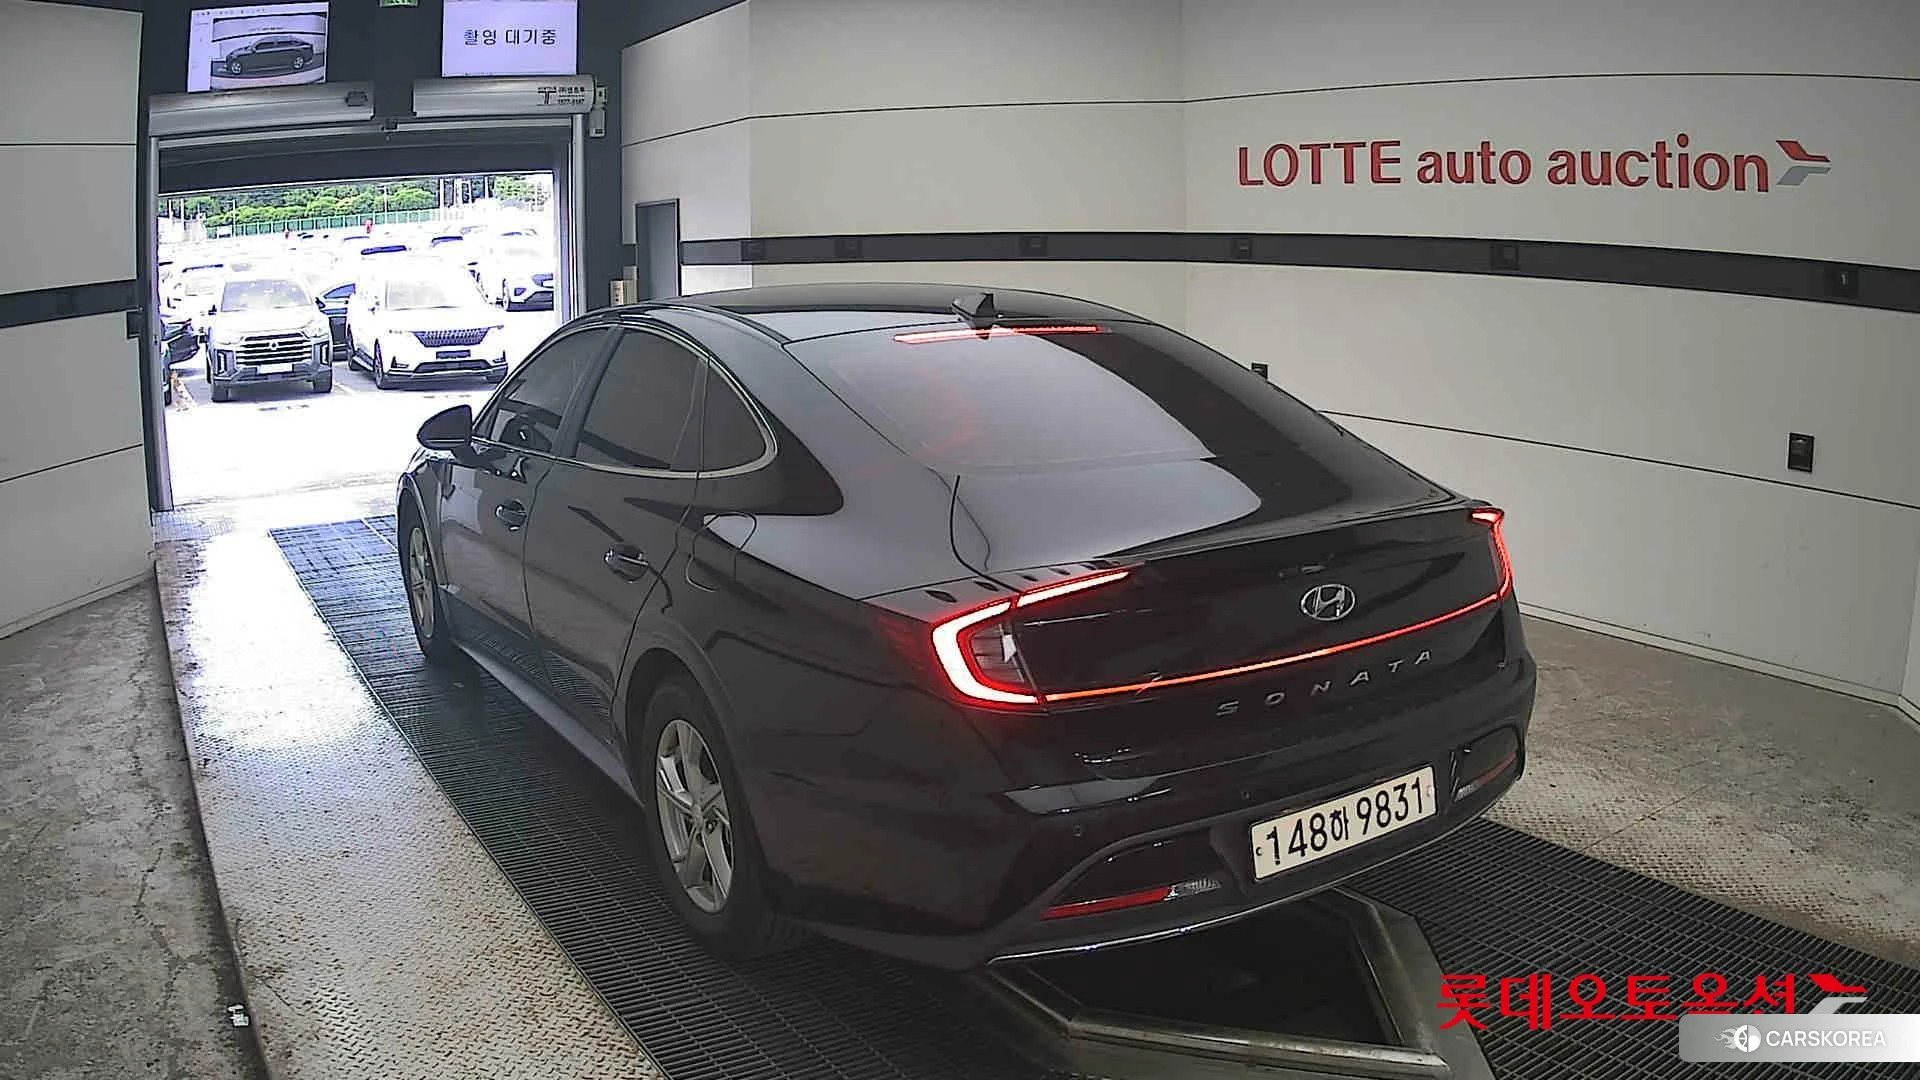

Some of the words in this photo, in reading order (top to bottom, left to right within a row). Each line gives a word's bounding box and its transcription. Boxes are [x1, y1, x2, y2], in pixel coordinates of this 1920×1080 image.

[505, 29, 557, 46] 대기중
[1238, 140, 1401, 187] LOTTE
[1416, 140, 1532, 185] auto
[1548, 132, 1769, 193] auction
[1216, 650, 1432, 716] SONATA
[1356, 776, 1423, 836] 9831
